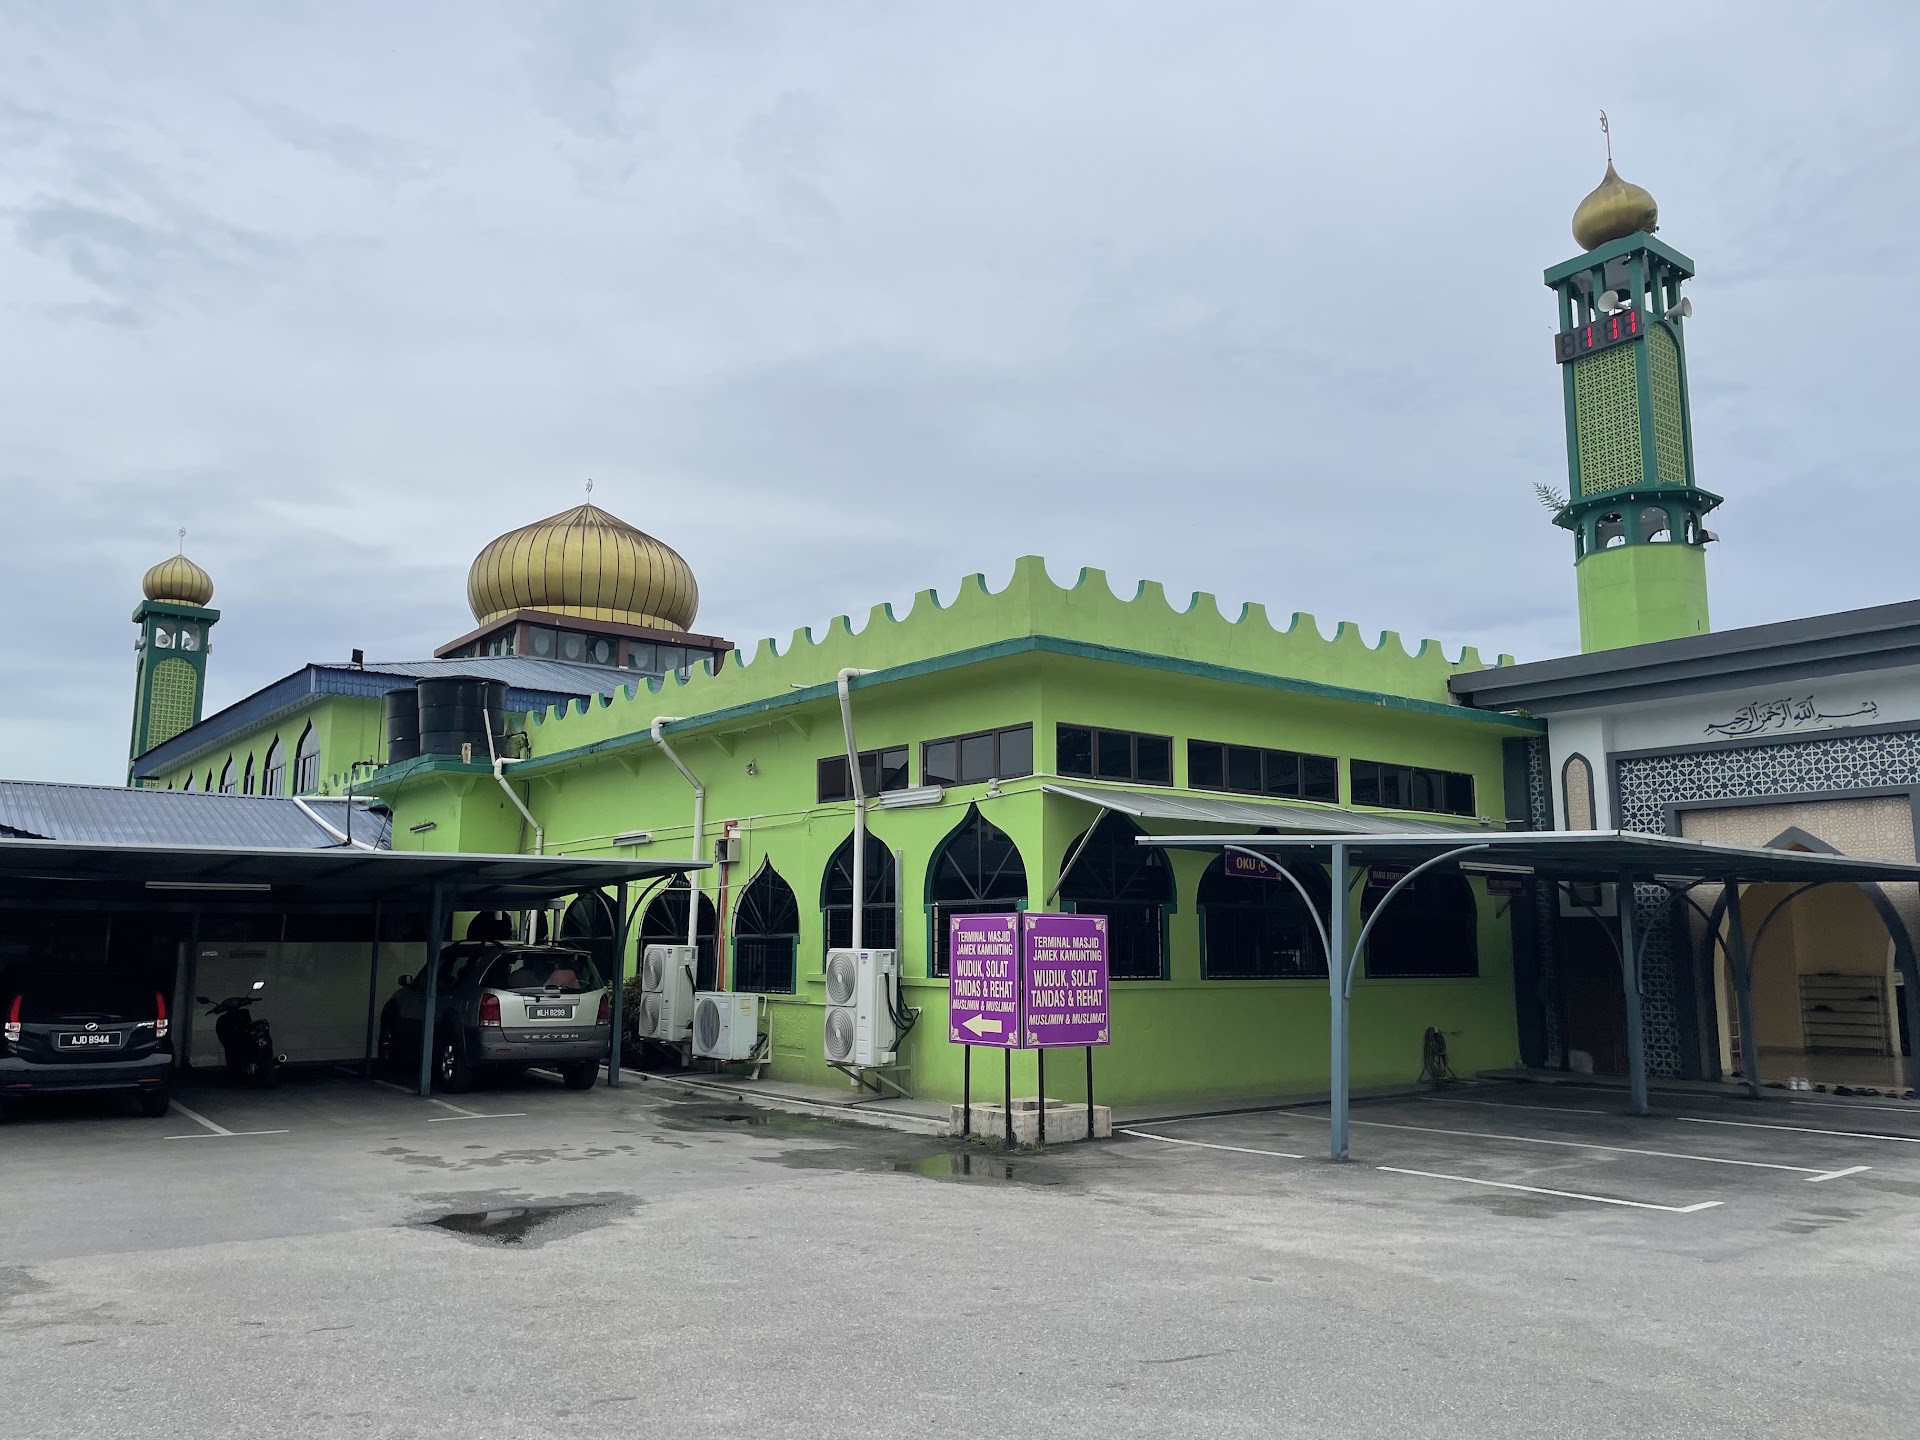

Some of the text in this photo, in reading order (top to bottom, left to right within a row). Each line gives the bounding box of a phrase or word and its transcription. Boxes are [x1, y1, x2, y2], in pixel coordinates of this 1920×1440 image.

[1236, 856, 1256, 870] OKU
[958, 931, 1010, 943] TERMINAL MASJID
[1034, 936, 1099, 948] TERMINAL MASJID
[957, 944, 1013, 956] JAMEK KAMUNTING
[1033, 950, 1102, 962] JAMEK KAMUNTING
[957, 960, 1008, 979] WUDUK, SOLAT
[1034, 970, 1097, 989] WUDUK, SOLAT
[955, 980, 1013, 998] TANDAS & REHAT
[1031, 990, 1103, 1007] TANDAS & REHAT
[953, 999, 1015, 1012] MUSLIMIN & MUSLIMAT
[1029, 1013, 1105, 1026] MUSLIMIN & MUSLIMAT
[72, 1035, 109, 1044] AJD 8944
